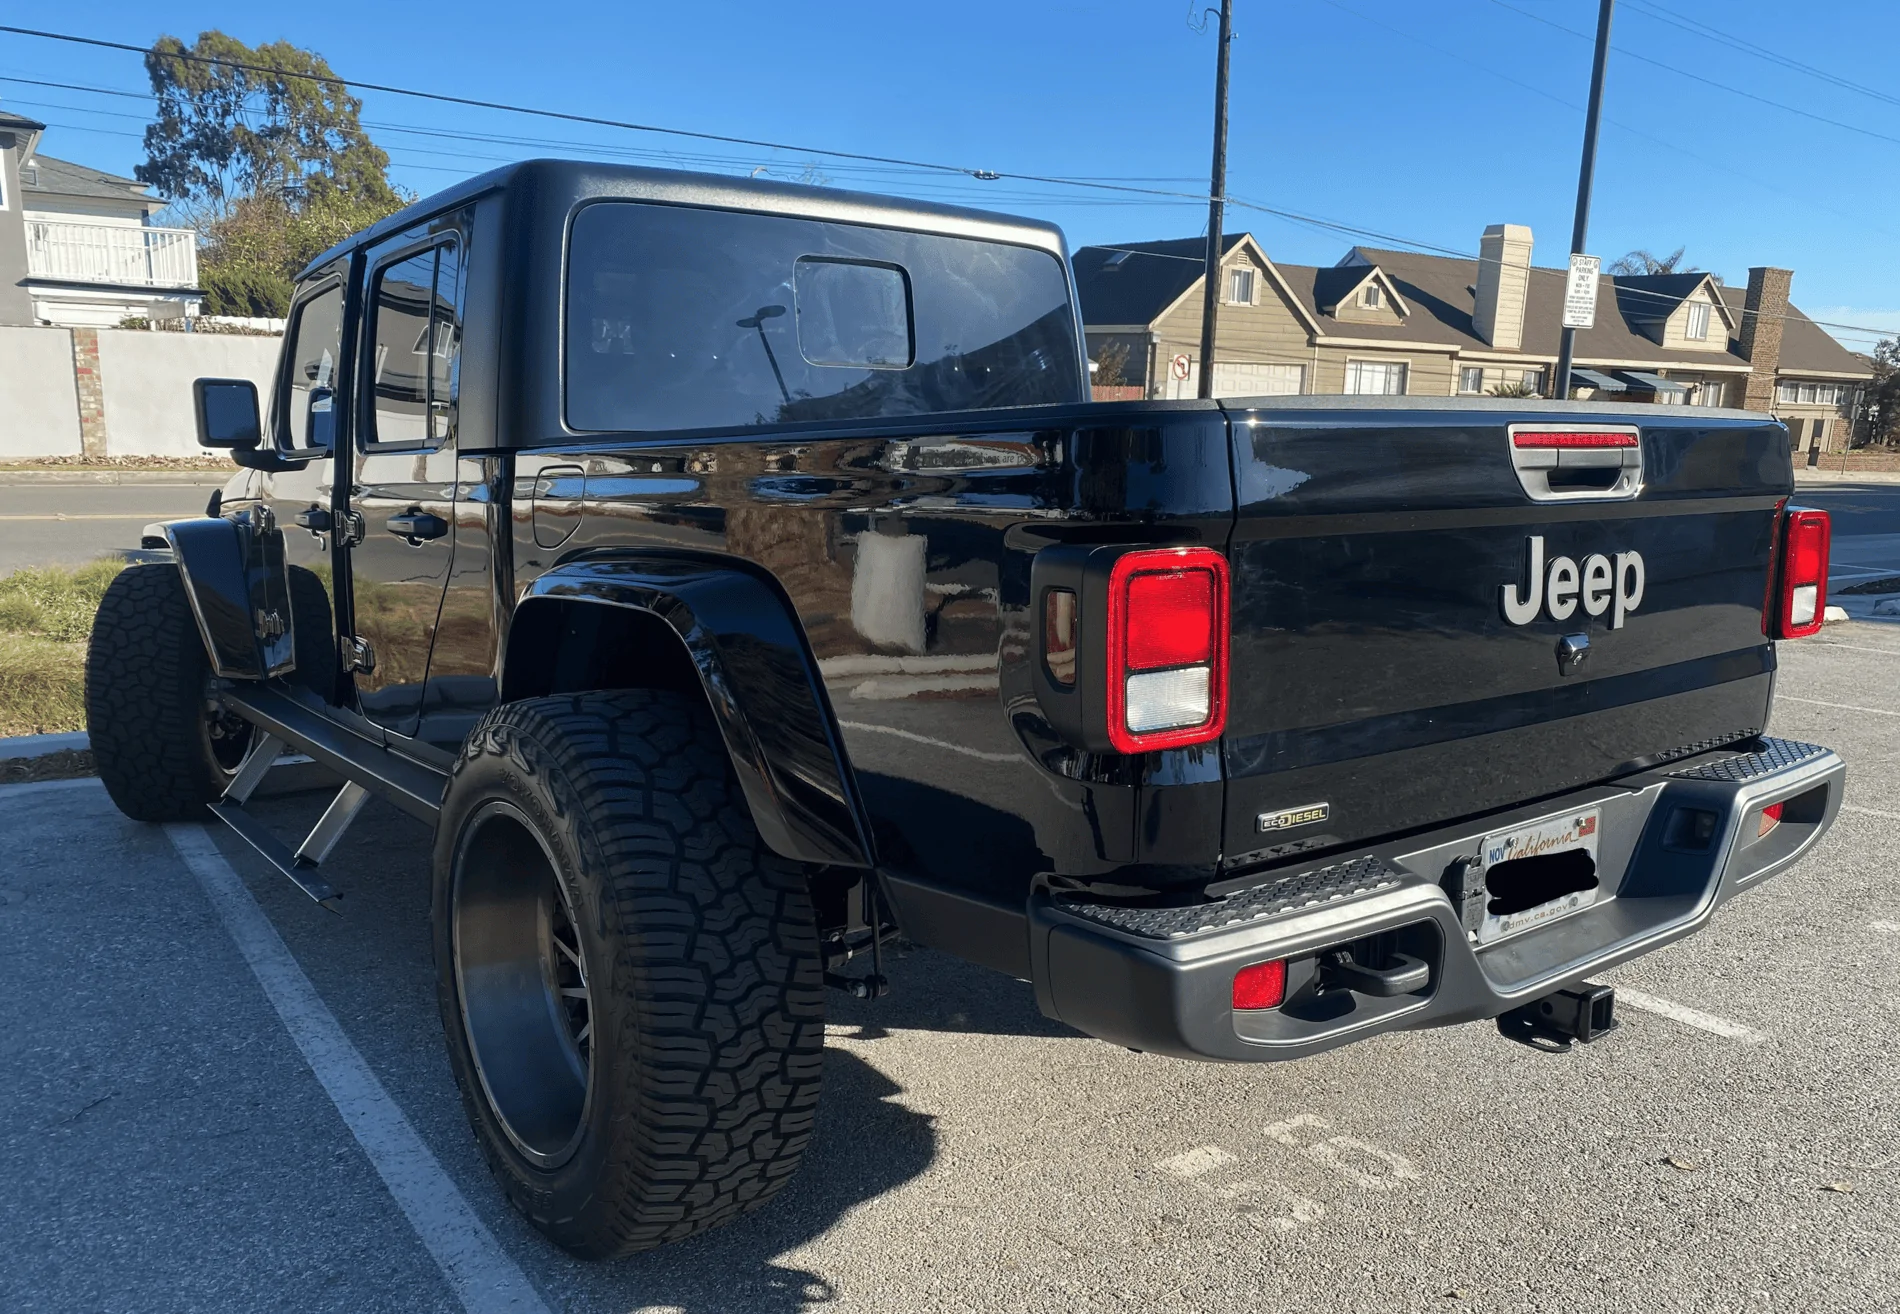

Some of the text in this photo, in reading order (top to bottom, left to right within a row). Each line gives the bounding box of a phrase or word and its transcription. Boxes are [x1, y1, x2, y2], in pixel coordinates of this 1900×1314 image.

[1576, 266, 1594, 275] PARKING
[1579, 259, 1592, 267] STAFF
[1578, 274, 1589, 282] ONLY
[1498, 535, 1645, 630] Jeep
[1489, 831, 1579, 864] NOV California
[1509, 903, 1568, 929] dmv.ca.gov
